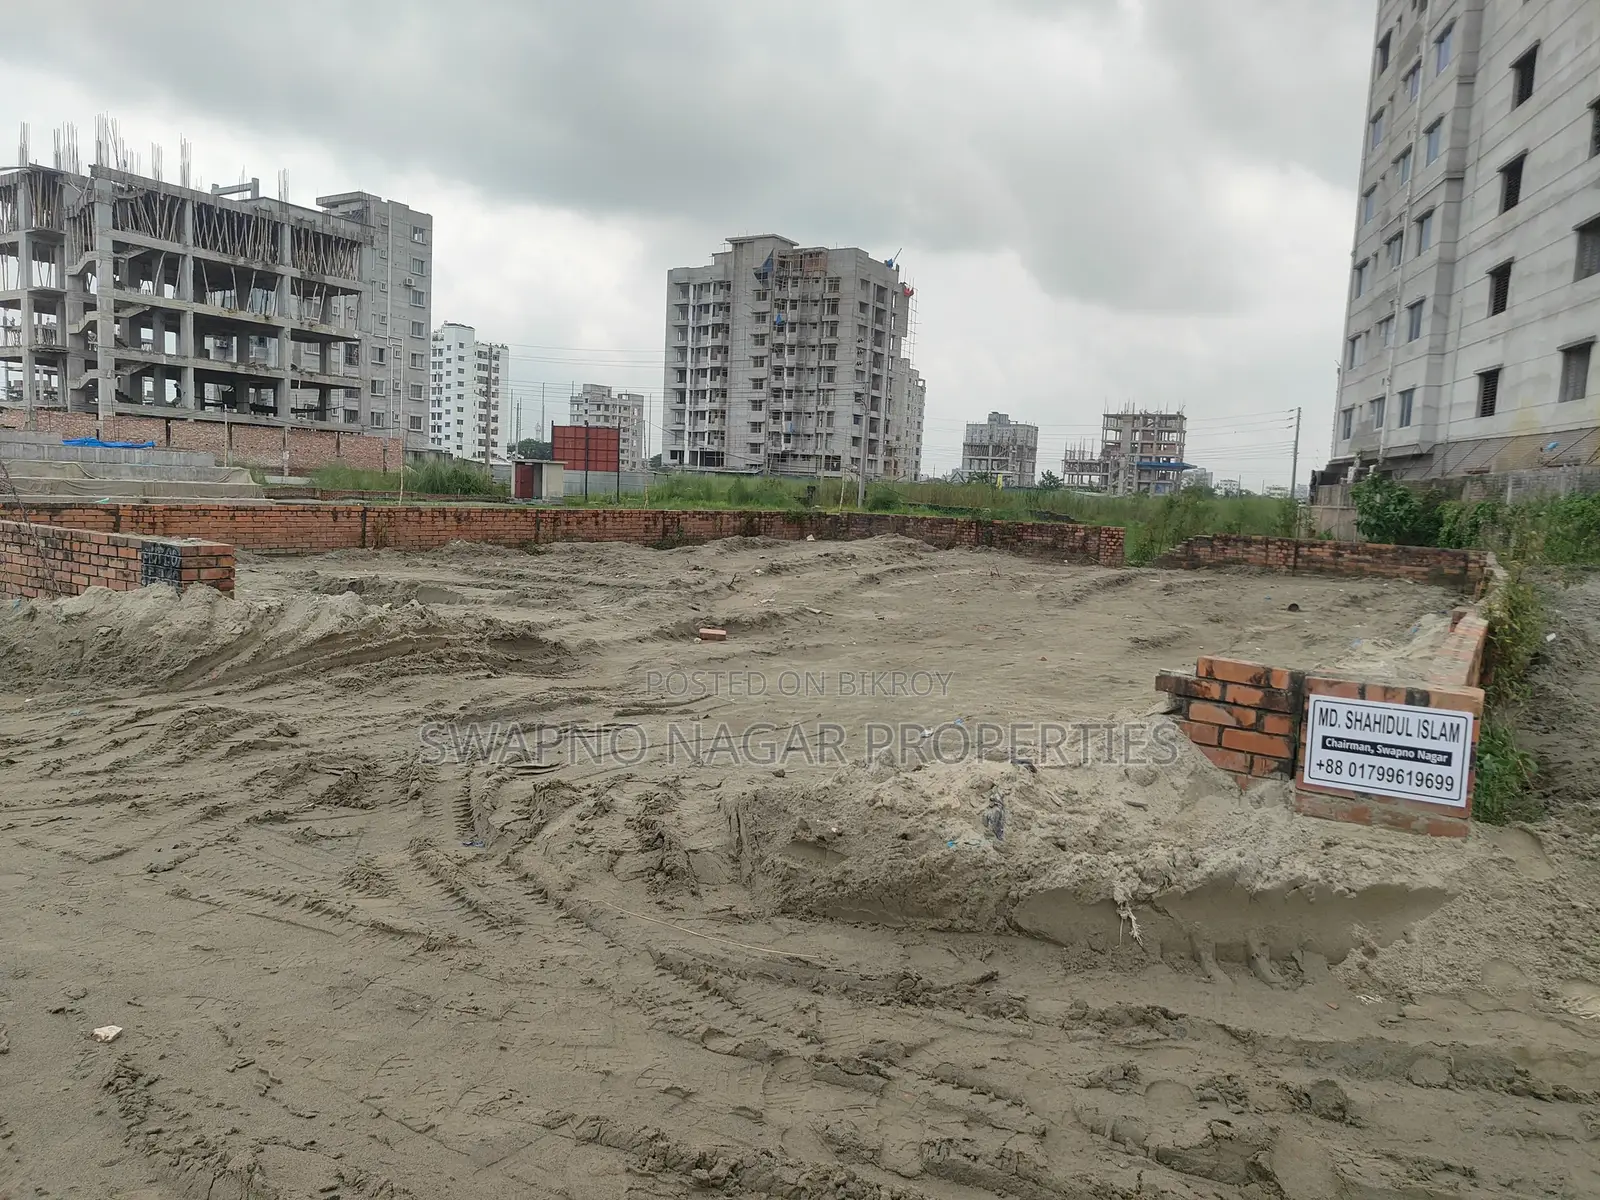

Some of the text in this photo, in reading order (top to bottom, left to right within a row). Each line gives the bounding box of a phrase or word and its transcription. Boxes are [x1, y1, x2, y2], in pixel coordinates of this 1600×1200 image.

[1318, 707, 1460, 743] MD. SHAHIDUL ISLAM
[1325, 737, 1448, 764] Chairman, Swapno Nagar
[1316, 758, 1455, 792] +88 01799619699
